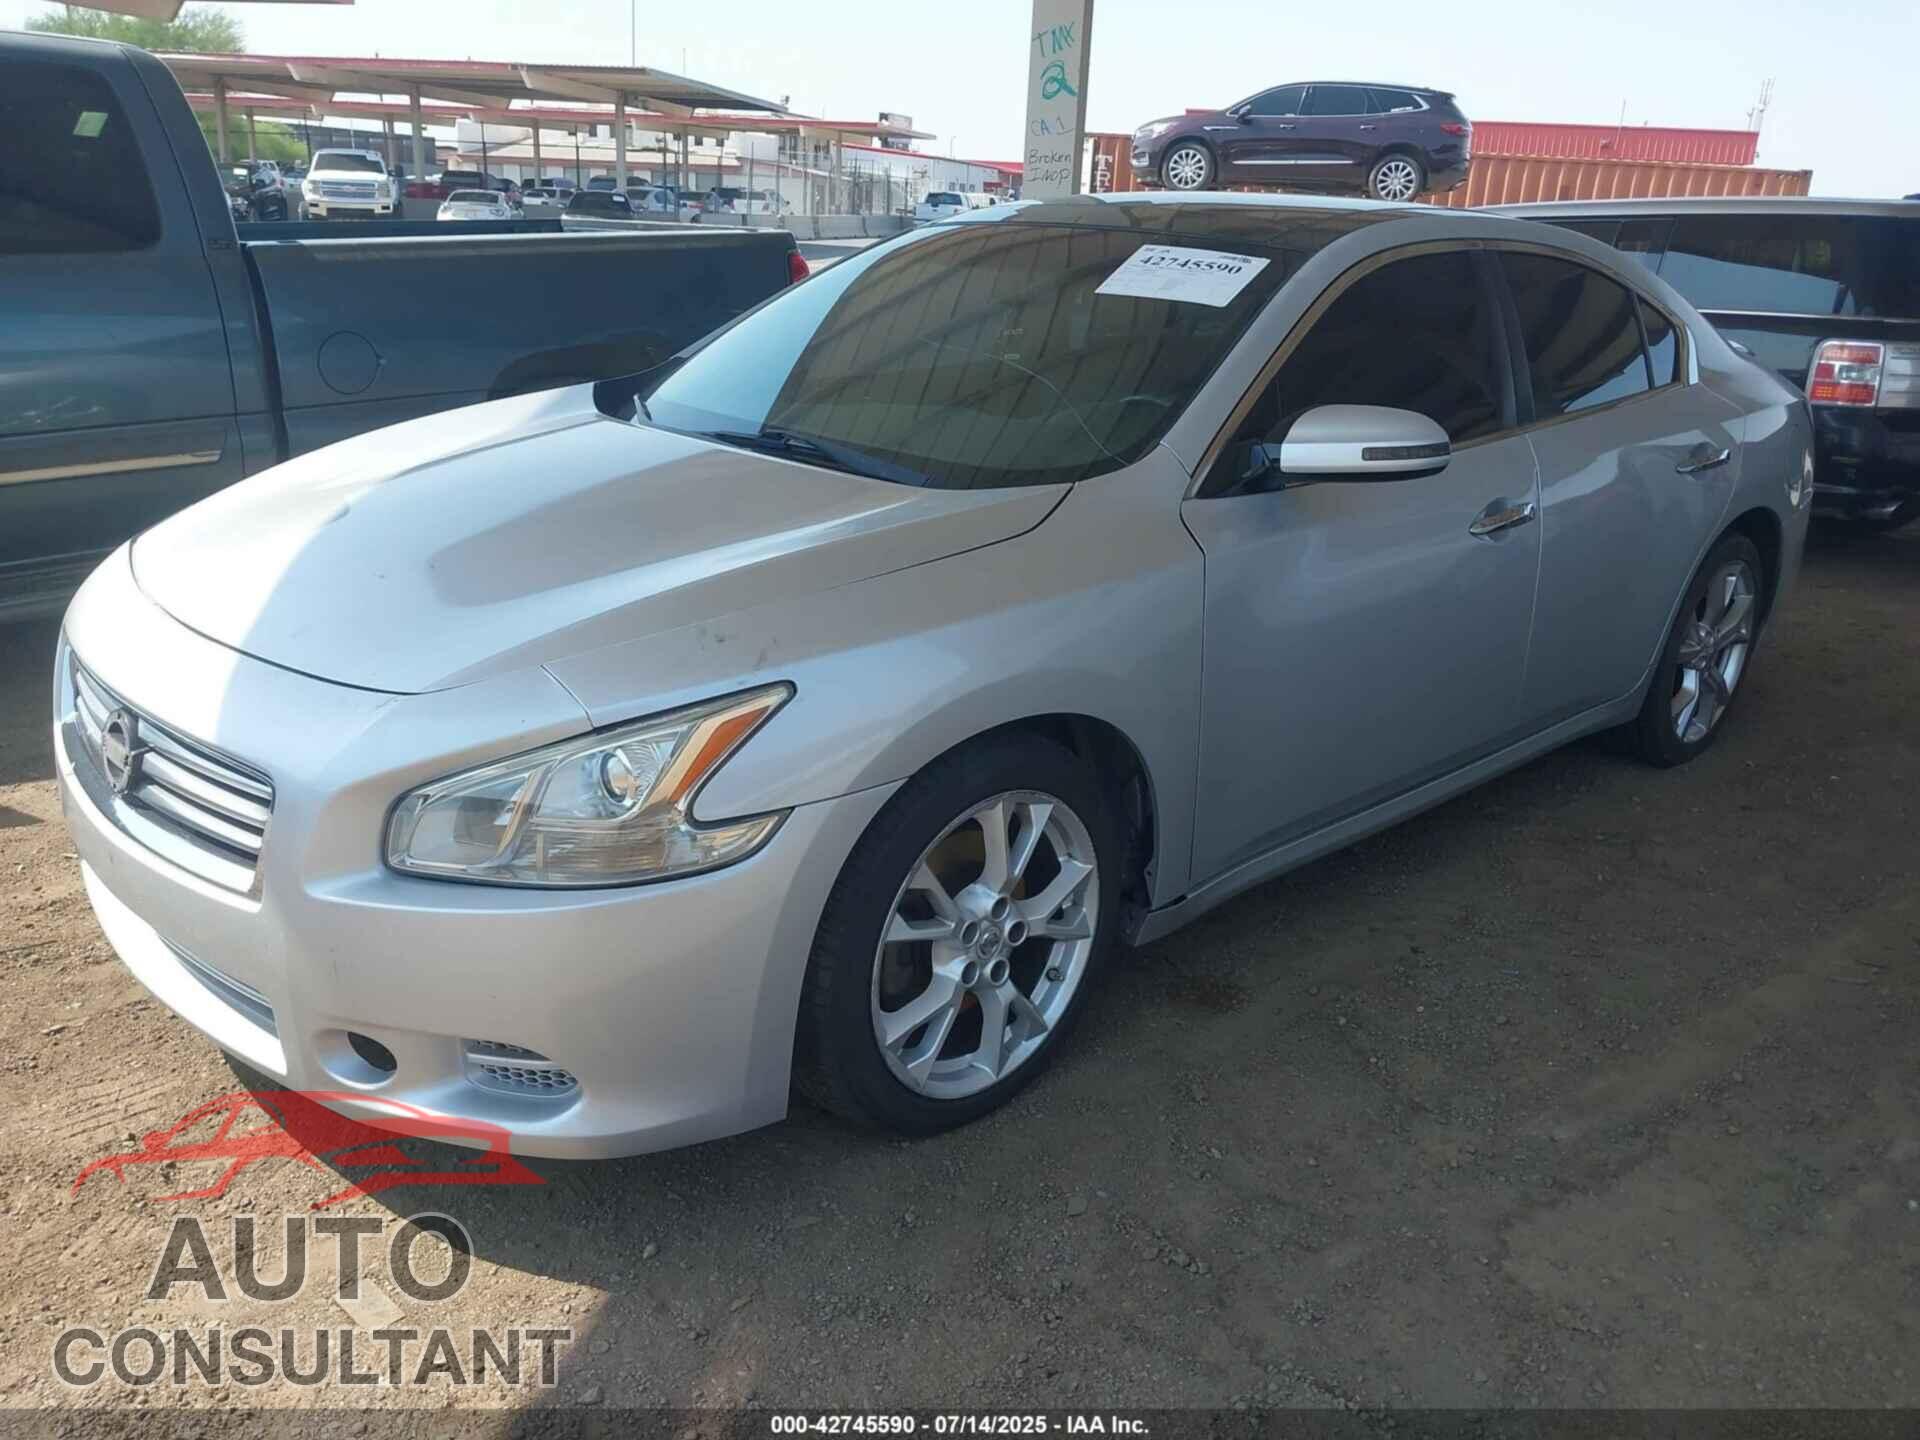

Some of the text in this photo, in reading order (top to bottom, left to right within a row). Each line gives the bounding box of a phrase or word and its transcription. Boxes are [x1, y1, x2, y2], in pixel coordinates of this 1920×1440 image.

[1040, 60, 1076, 100] 2
[1029, 149, 1072, 165] Broken
[1140, 255, 1243, 275] 42745590
